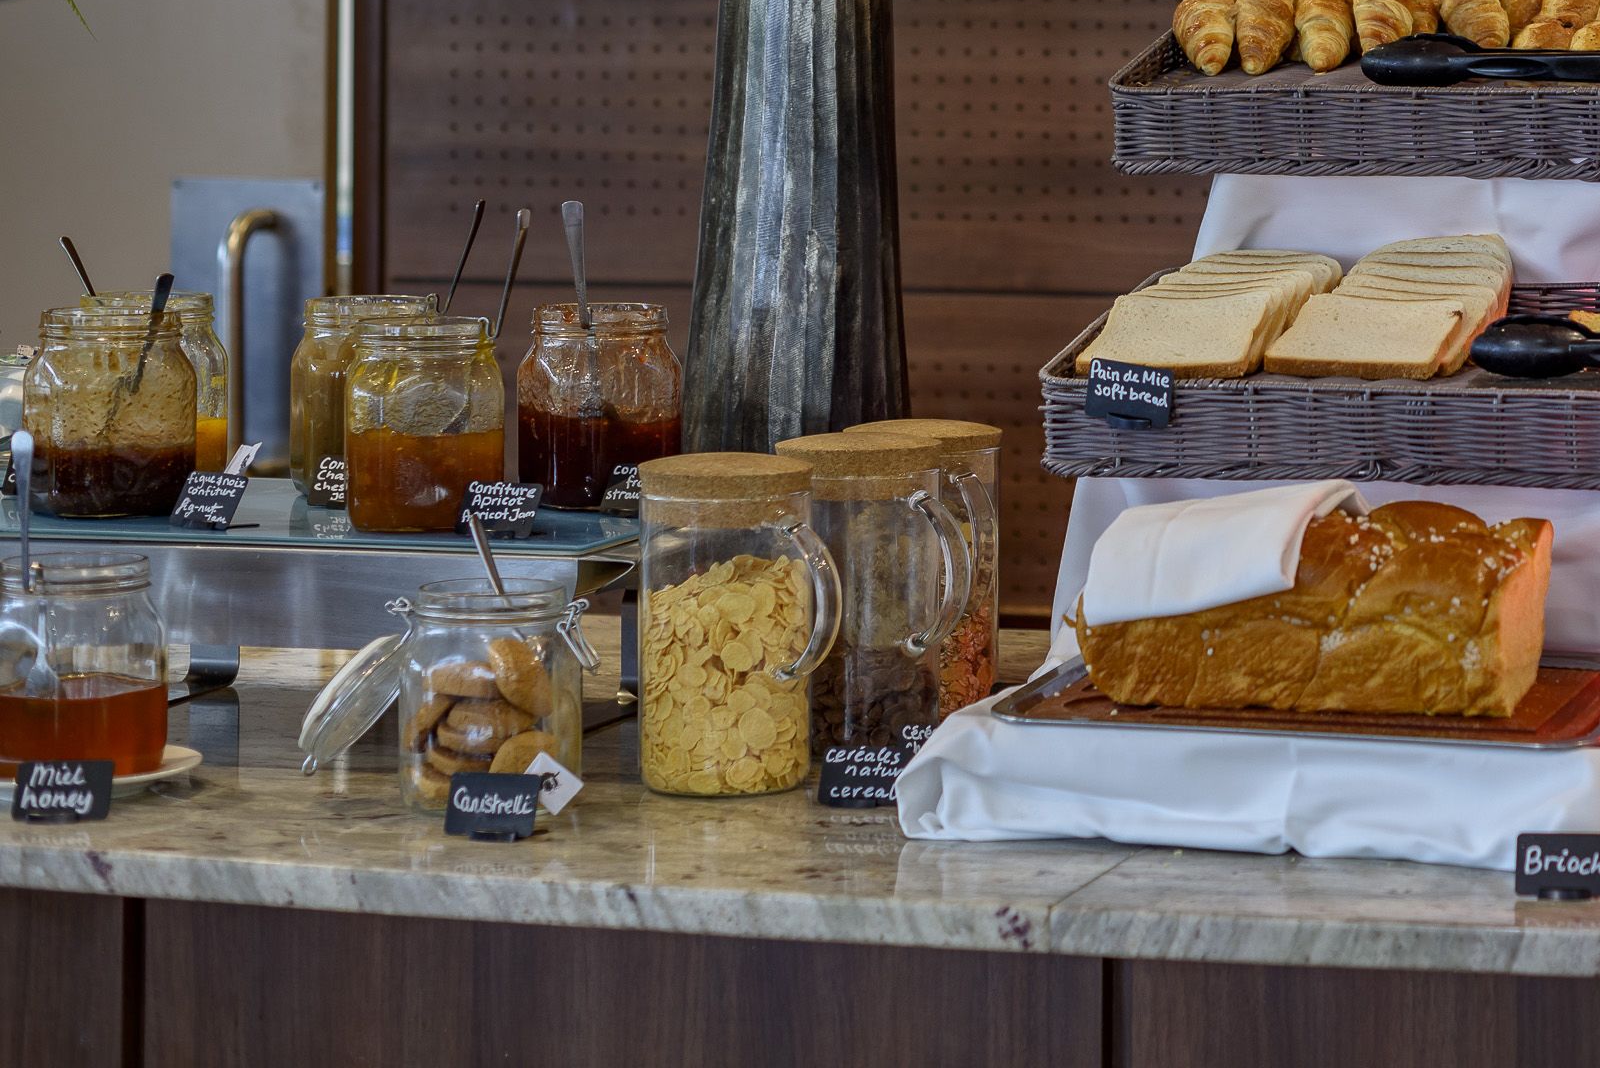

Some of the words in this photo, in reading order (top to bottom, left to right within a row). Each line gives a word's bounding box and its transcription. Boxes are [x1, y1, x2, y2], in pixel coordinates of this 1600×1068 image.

[1090, 359, 1120, 382] Pain
[1123, 370, 1140, 383] de
[1142, 370, 1170, 388] Mie
[1129, 386, 1168, 408] bread
[468, 480, 537, 499] Confiture
[471, 494, 526, 509] Apricot
[508, 507, 536, 522] Jam
[29, 762, 88, 788] Miel
[20, 783, 94, 814] honey
